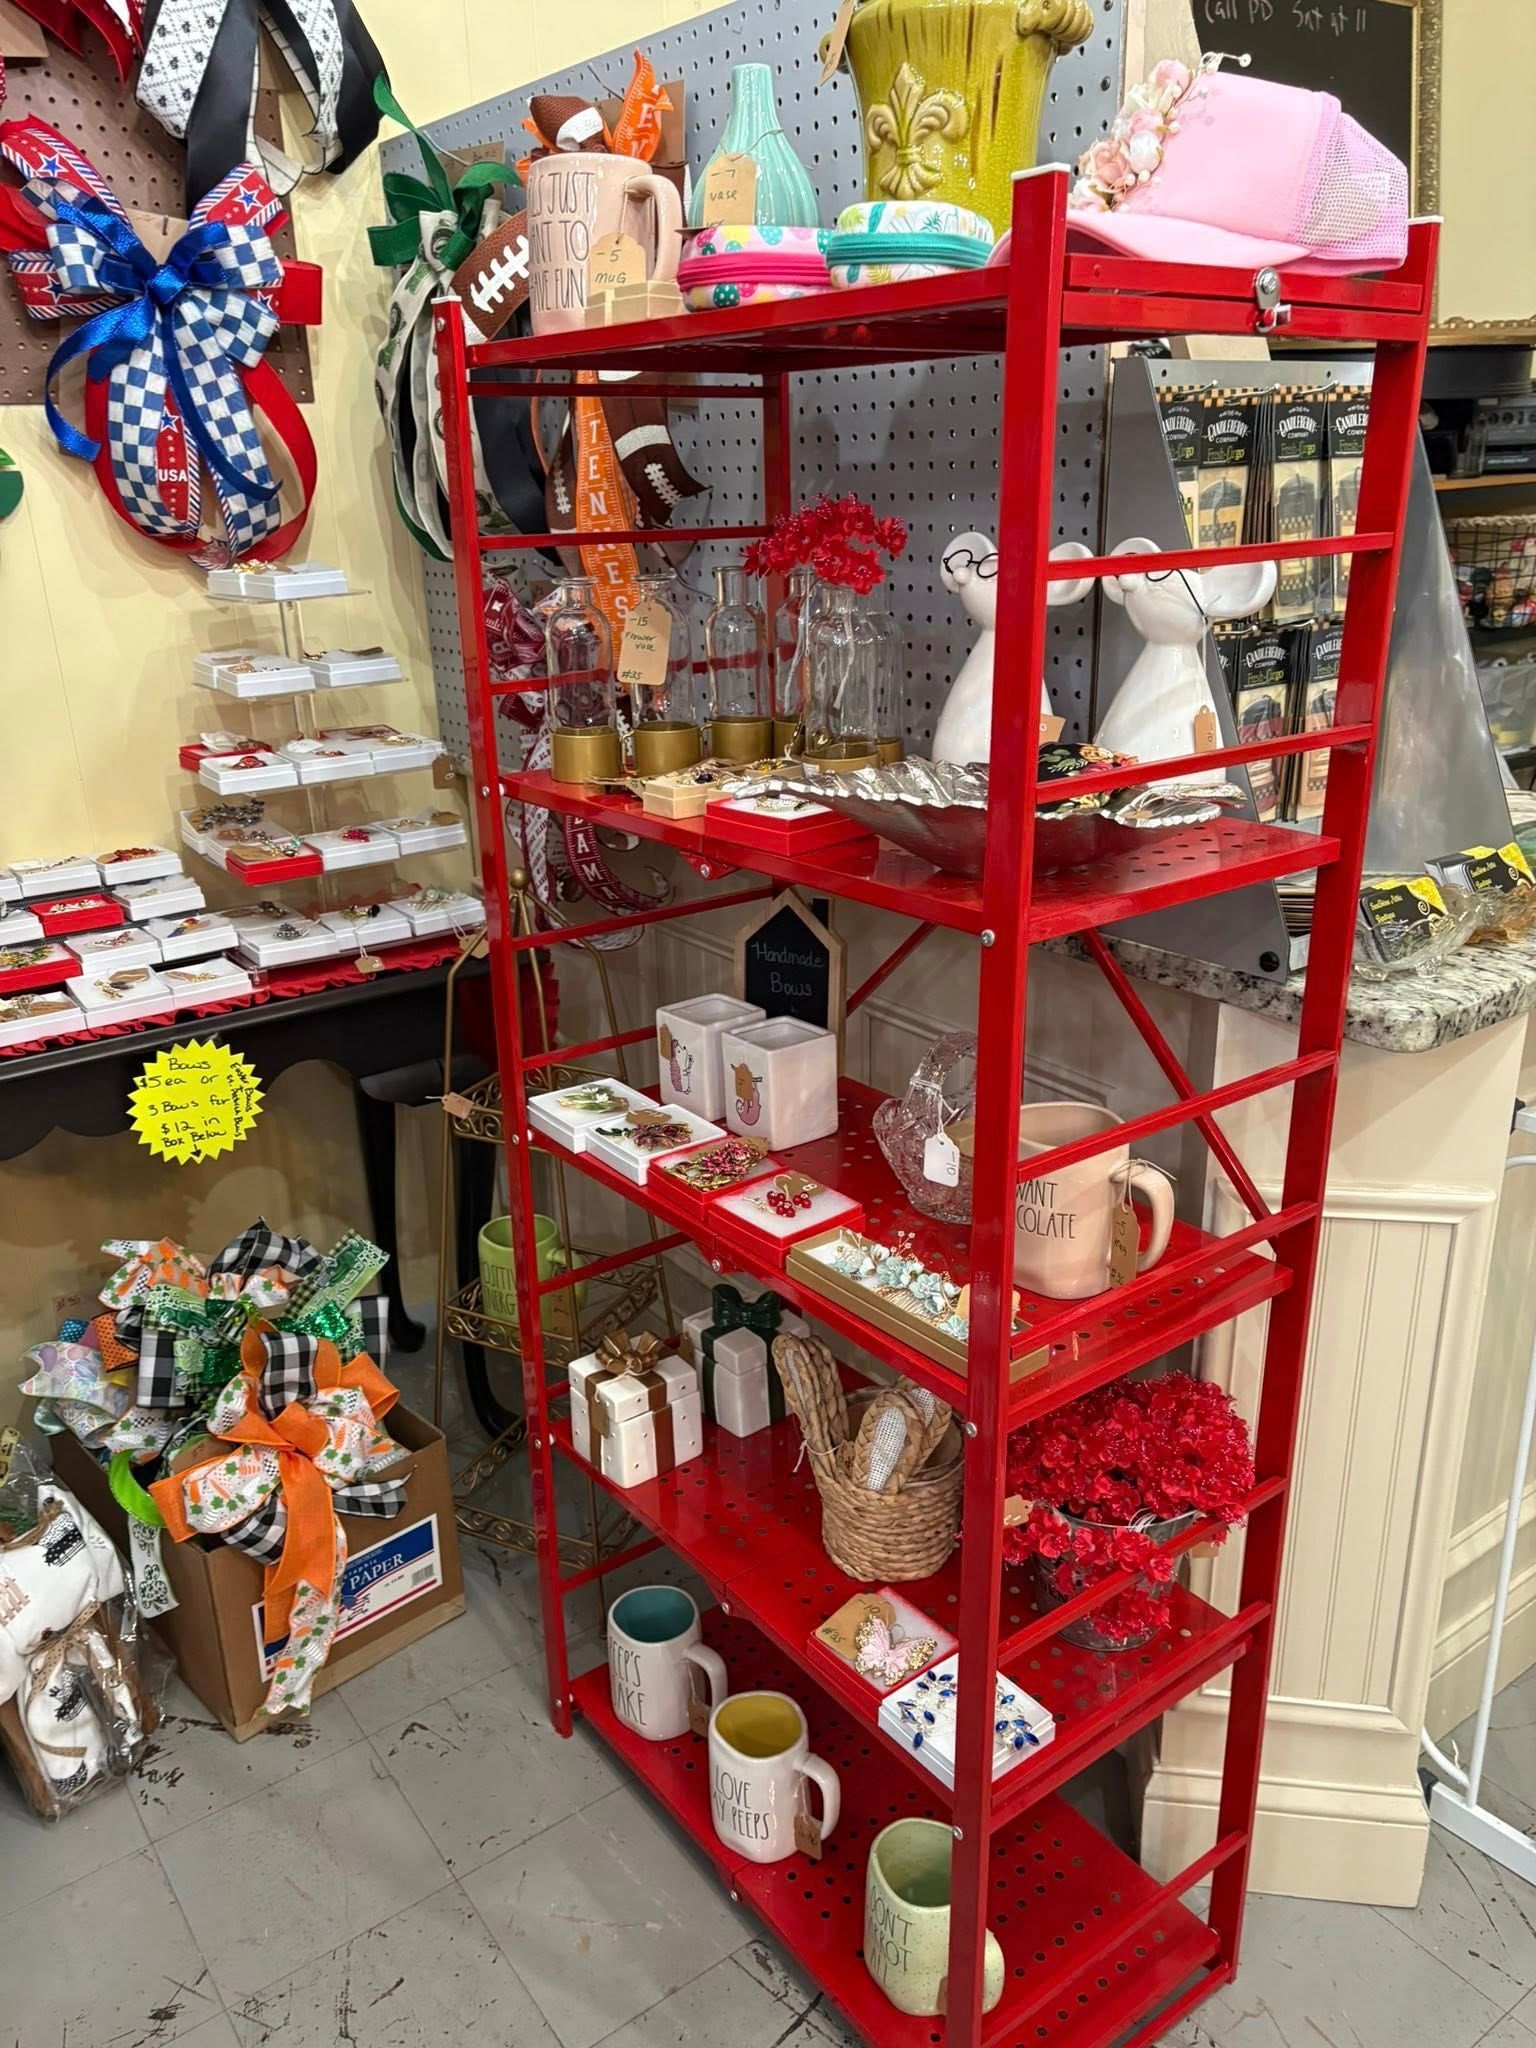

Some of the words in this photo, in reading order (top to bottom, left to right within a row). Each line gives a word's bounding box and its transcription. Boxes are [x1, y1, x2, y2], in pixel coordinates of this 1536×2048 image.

[547, 171, 596, 216] JUST
[559, 220, 590, 262] TO
[554, 266, 585, 311] FUN
[158, 468, 188, 482] USA
[751, 942, 825, 968] Handmade
[770, 971, 813, 996] Bows
[168, 1057, 211, 1071] Bows
[200, 1074, 220, 1084] or
[148, 1104, 158, 1117] 3
[162, 1100, 199, 1113] Bows
[201, 1116, 221, 1127] in
[190, 1129, 227, 1142] Below
[350, 1553, 405, 1590] PAPER
[613, 1682, 648, 1726] AKE
[714, 1764, 751, 1809] LOVE
[731, 1806, 770, 1841] PEEPS
